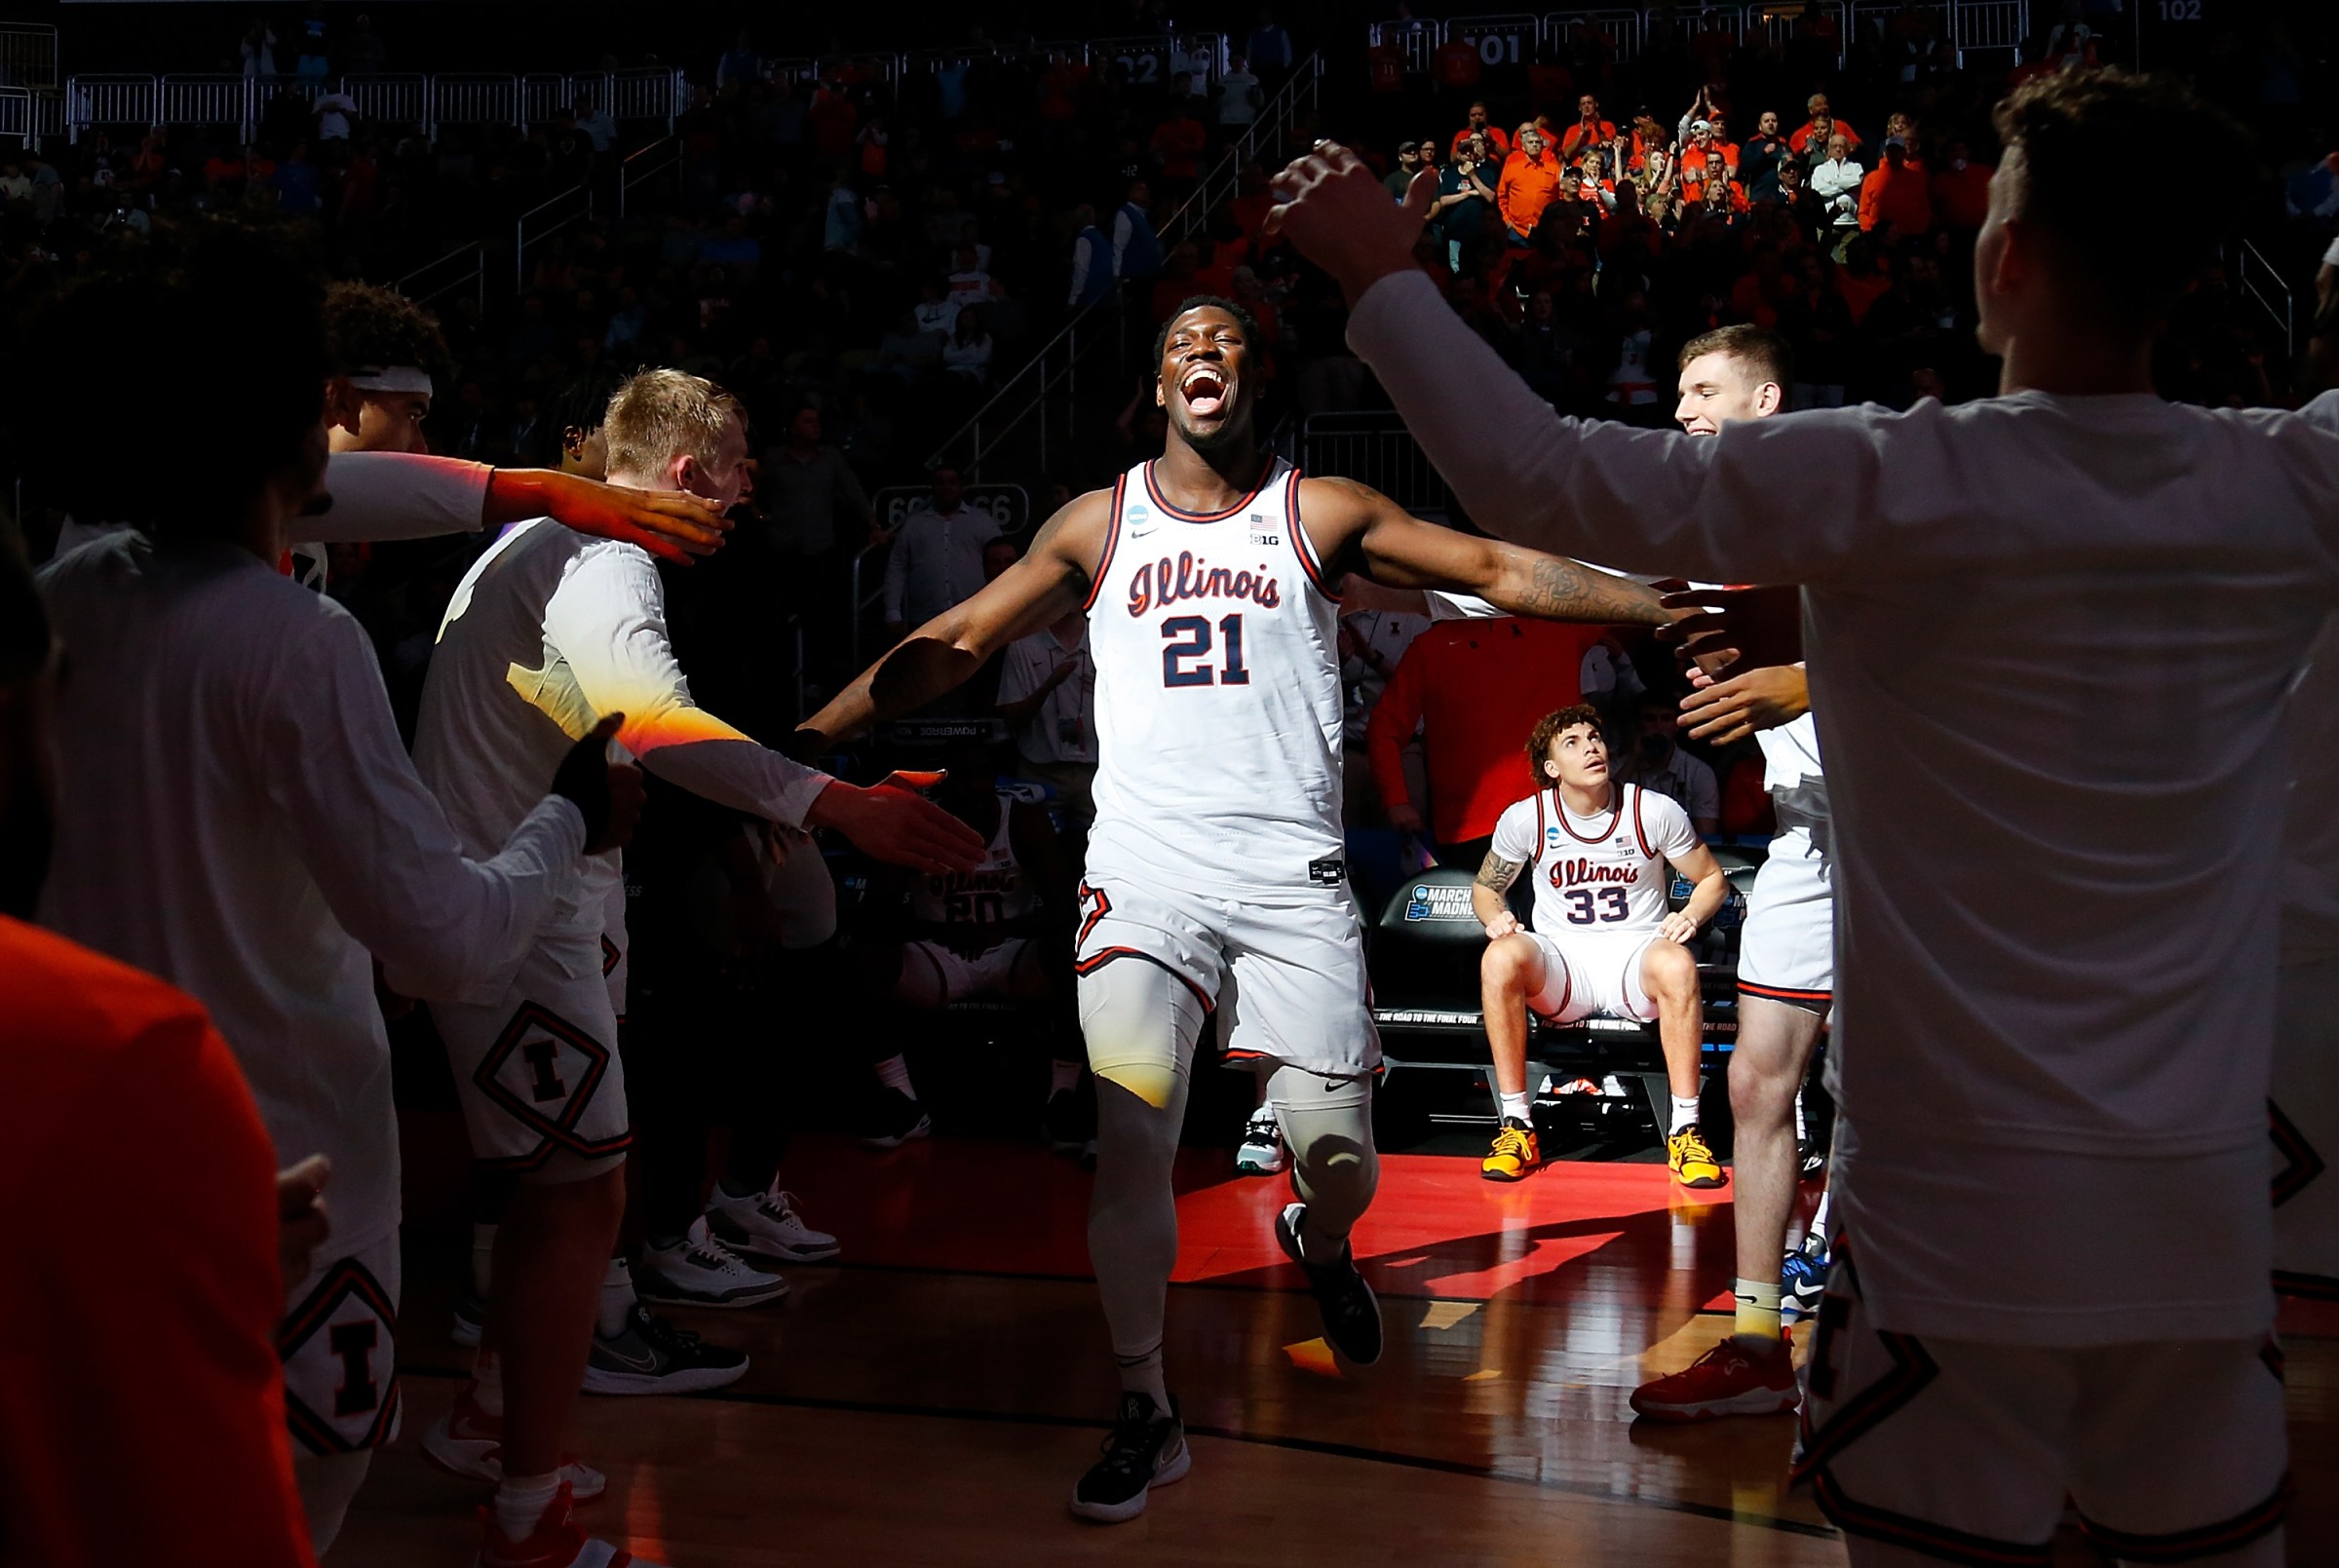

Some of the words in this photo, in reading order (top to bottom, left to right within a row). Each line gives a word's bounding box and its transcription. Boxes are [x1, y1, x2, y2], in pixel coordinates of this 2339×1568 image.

[2157, 0, 2203, 21] 102
[1127, 550, 1281, 619] Illinois
[1160, 613, 1250, 689] 21
[1550, 858, 1638, 889] Illinois
[1427, 888, 1472, 902] MARCH
[1564, 886, 1630, 925] 33
[1378, 1013, 1393, 1022] THE
[1393, 1013, 1413, 1023] ROAD
[1413, 1013, 1423, 1023] TO
[1423, 1013, 1437, 1023] THE
[1437, 1014, 1458, 1024] FINAL
[1458, 1015, 1479, 1025] FOUR
[523, 1040, 565, 1102] I
[330, 1319, 377, 1418] I
